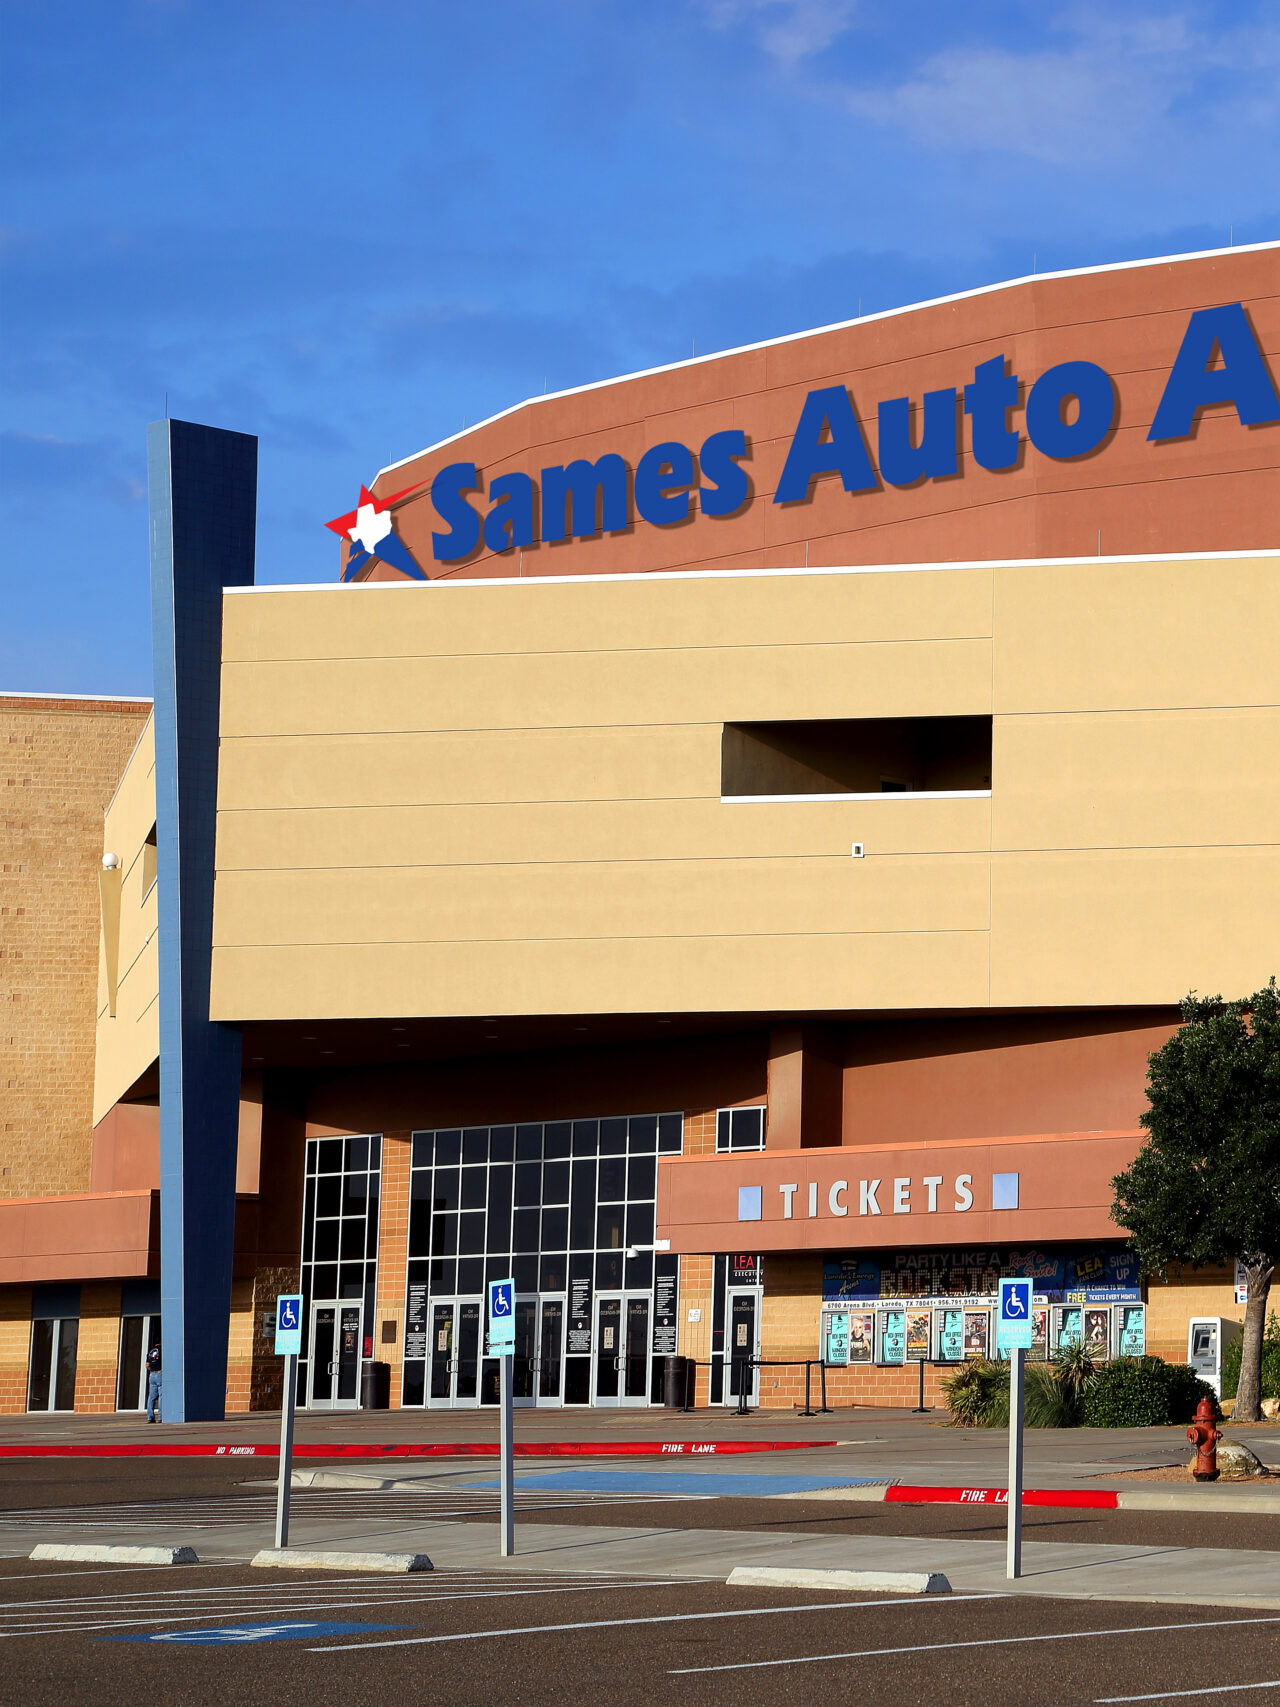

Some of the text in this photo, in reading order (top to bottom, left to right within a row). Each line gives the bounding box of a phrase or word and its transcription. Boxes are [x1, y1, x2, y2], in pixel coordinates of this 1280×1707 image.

[431, 429, 750, 562] Sames
[772, 353, 1115, 505] Auto
[779, 1174, 974, 1219] TICKETS
[734, 1255, 754, 1269] LEA
[895, 1252, 1001, 1268] PARTY LIKE A
[1008, 1249, 1037, 1270] Rent
[1075, 1256, 1103, 1277] LEA
[1109, 1253, 1134, 1268] SIGN
[1116, 1267, 1130, 1280] UP
[1066, 1292, 1087, 1303] FREE
[215, 1446, 255, 1455] NO PARKING
[661, 1444, 717, 1453] FIRE LANE
[960, 1490, 988, 1502] FIRE
